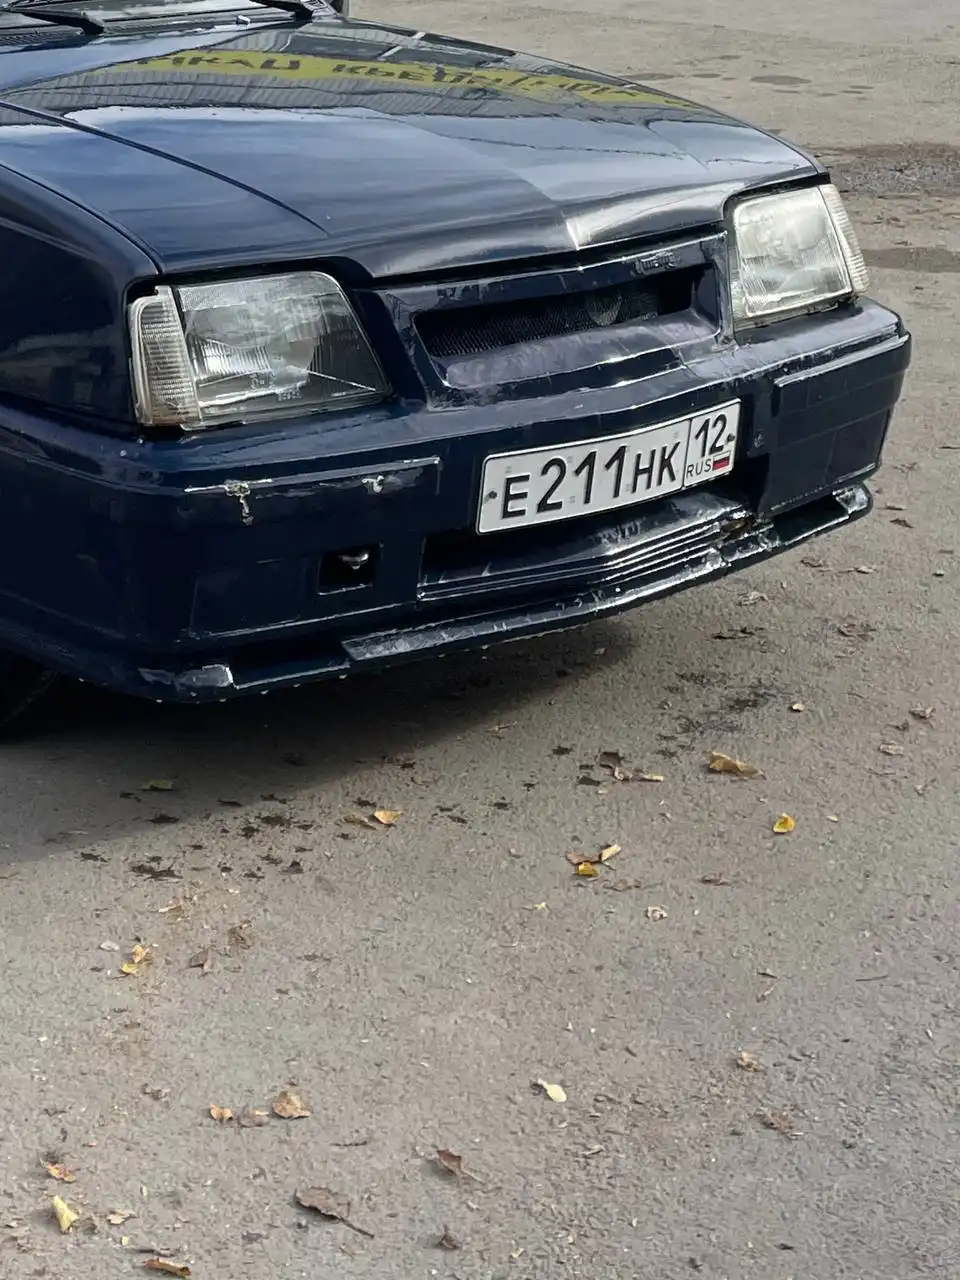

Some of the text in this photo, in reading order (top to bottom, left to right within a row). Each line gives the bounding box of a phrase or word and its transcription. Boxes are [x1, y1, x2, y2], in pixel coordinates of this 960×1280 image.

[502, 413, 727, 519] Е211НК 12
[686, 458, 712, 478] RUS
